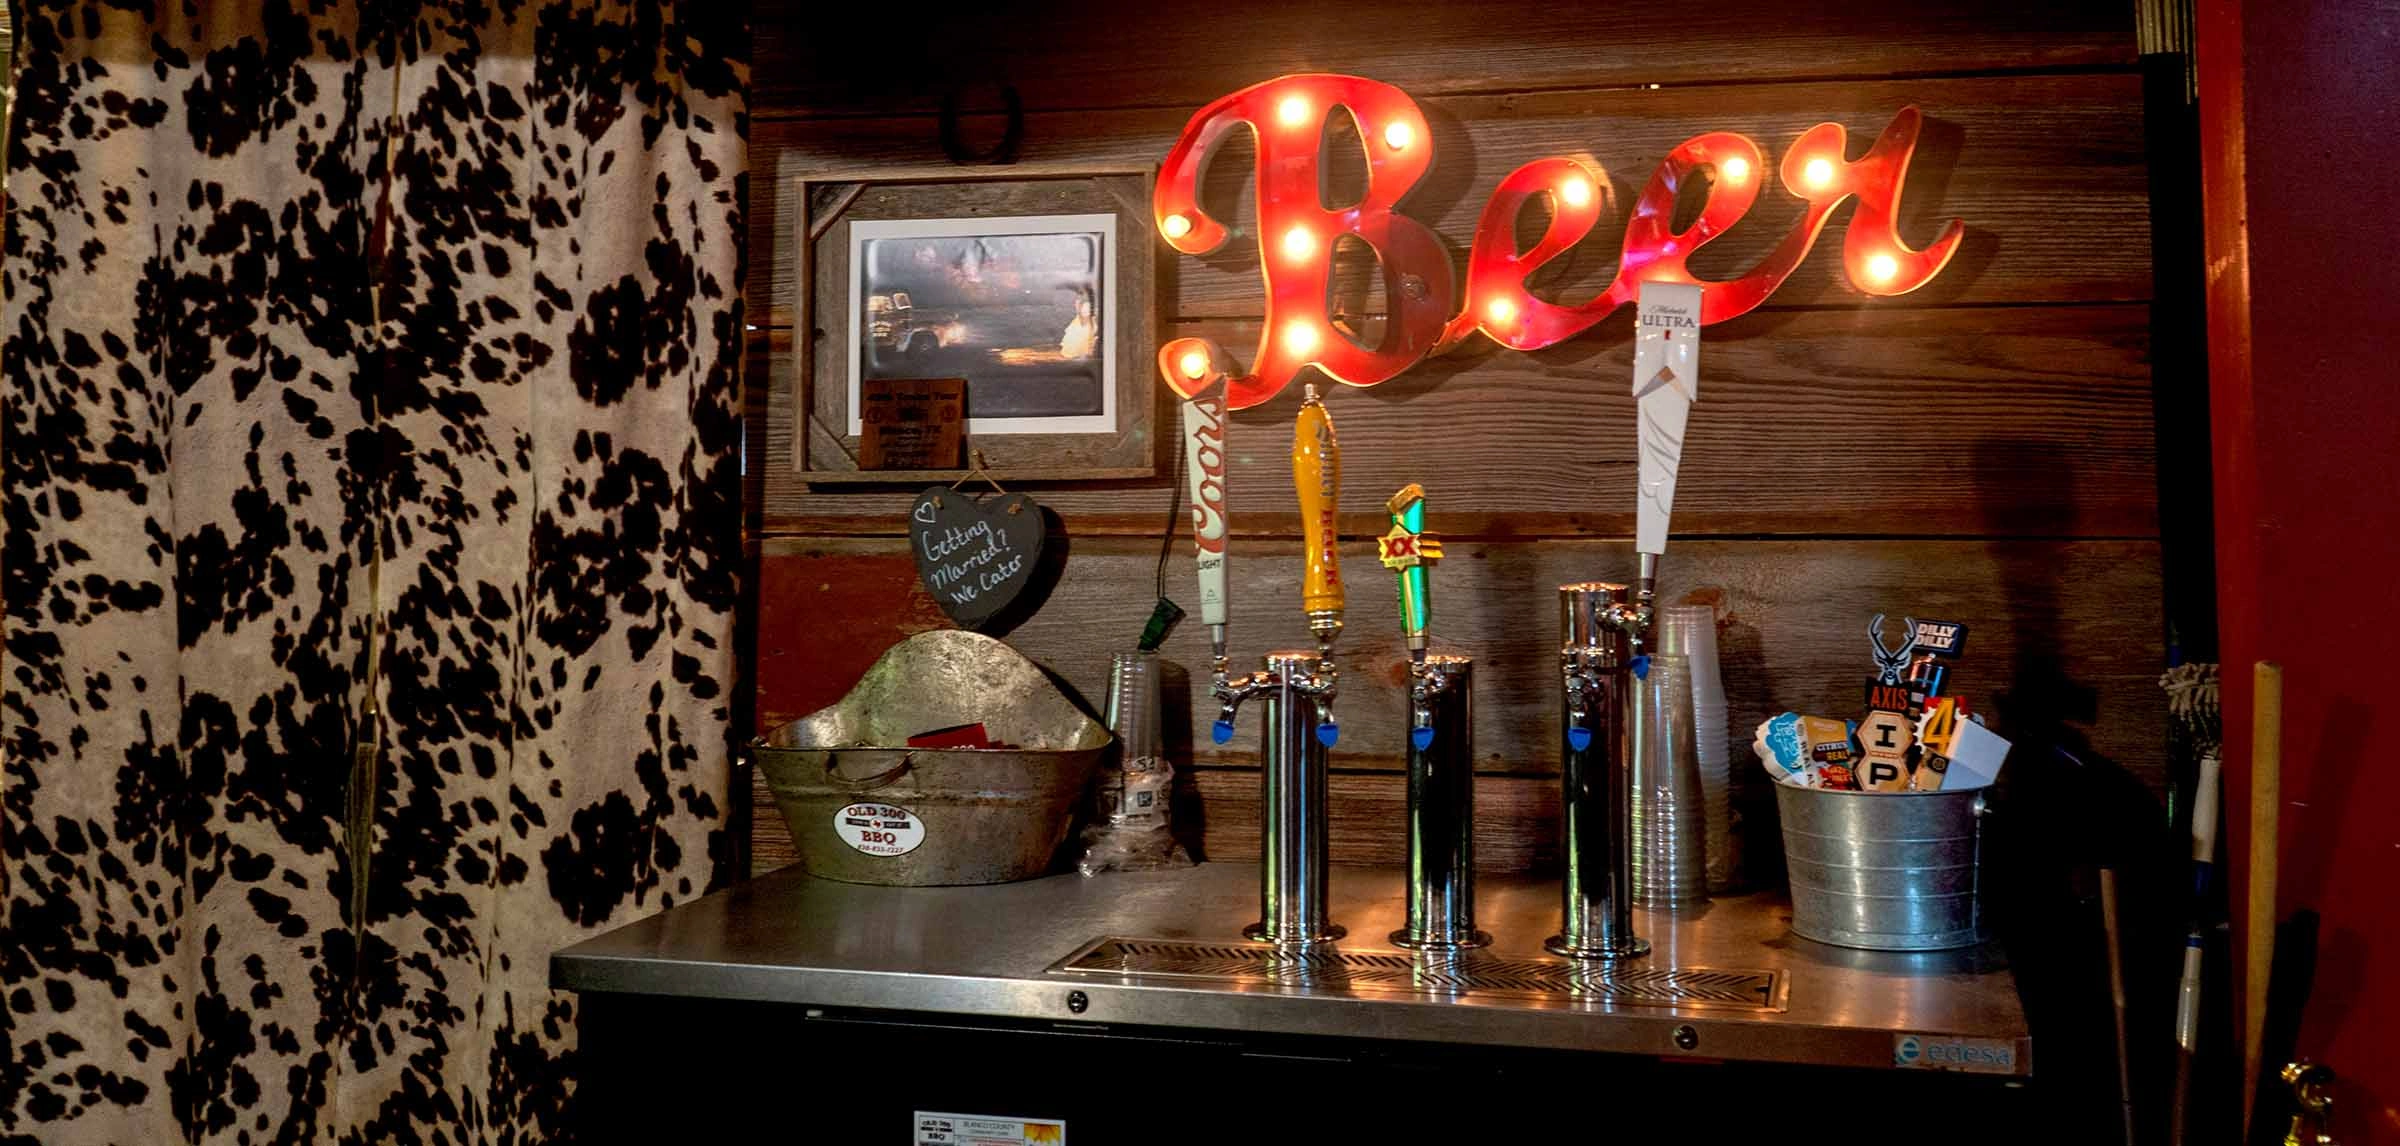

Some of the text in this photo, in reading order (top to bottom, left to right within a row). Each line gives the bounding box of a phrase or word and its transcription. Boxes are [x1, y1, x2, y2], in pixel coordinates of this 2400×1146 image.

[1154, 73, 1965, 410] Beer
[1642, 314, 1697, 329] ULTRA
[1193, 396, 1225, 554] Coors
[922, 520, 994, 562] Getting
[1383, 535, 1417, 560] XX
[930, 528, 1011, 590] Married?
[950, 553, 1022, 604] We Cater
[1915, 635, 1955, 649] DILLY
[1918, 623, 1959, 637] DILLY
[1869, 685, 1909, 711] AXIS
[1922, 697, 1956, 758] 4
[847, 806, 877, 817] OLD
[861, 830, 897, 846] BBQ
